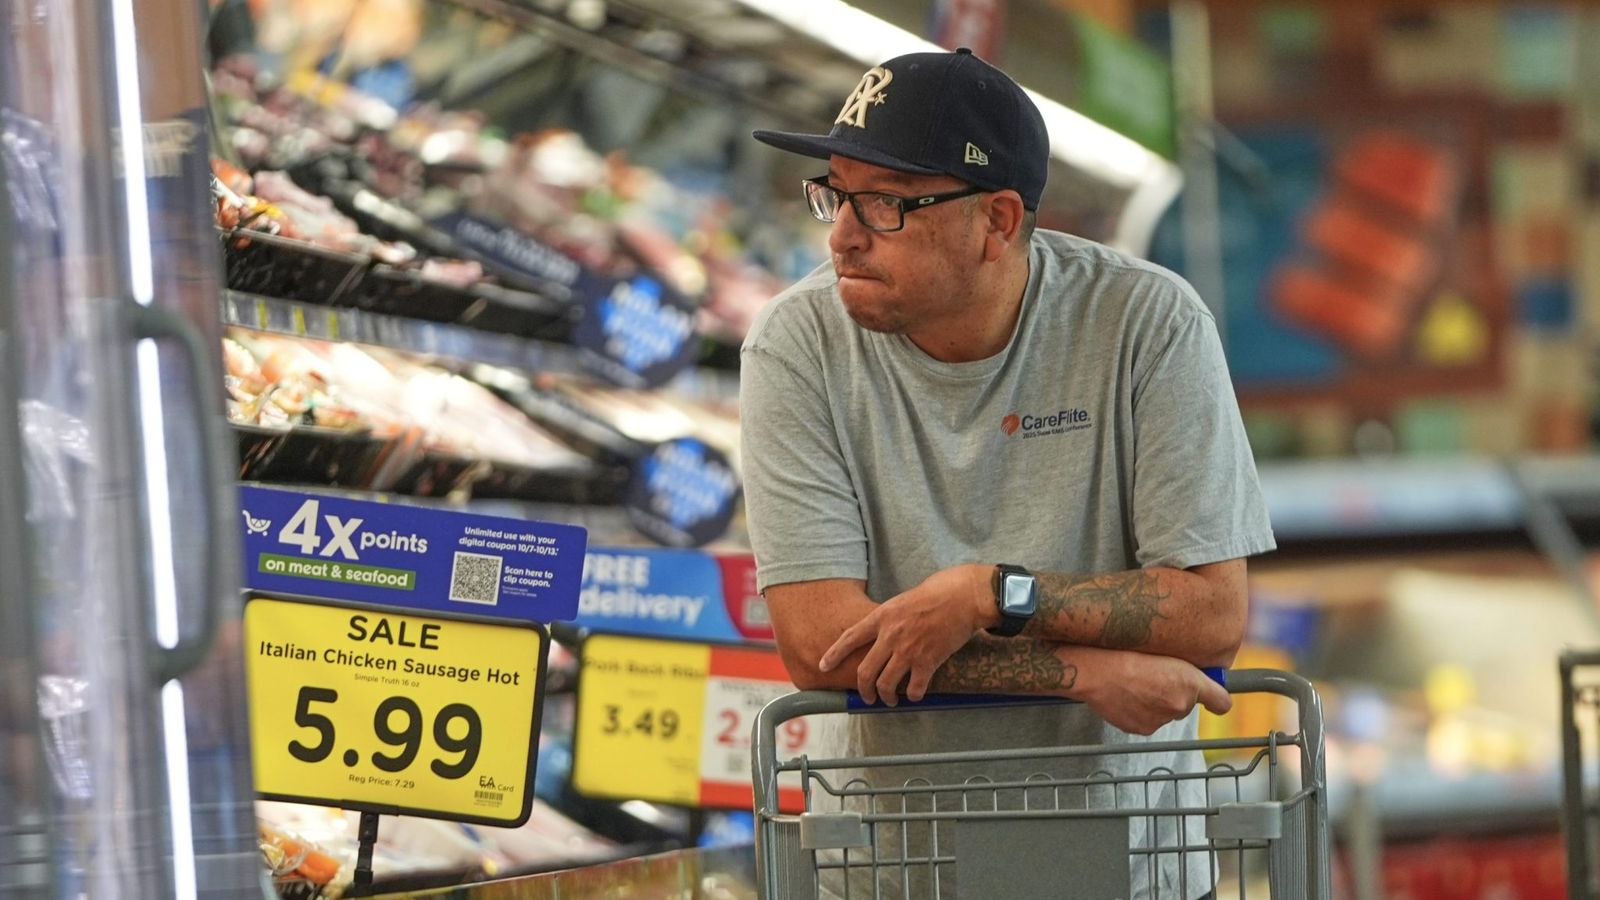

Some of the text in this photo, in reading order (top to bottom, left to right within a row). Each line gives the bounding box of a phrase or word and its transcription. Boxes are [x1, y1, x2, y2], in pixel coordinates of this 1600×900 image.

[360, 531, 428, 553] points
[458, 537, 485, 547] digital
[486, 541, 516, 551] coupon
[464, 527, 556, 545] Unlimited use with your
[265, 559, 408, 587] on meat & seafood
[503, 575, 551, 587] clip coupon.
[504, 566, 553, 579] Scan here to
[584, 553, 650, 587] FREE
[578, 587, 705, 627] delivery
[347, 615, 441, 650] SALE
[260, 641, 520, 685] Italian Chicken Sausage Hot
[354, 673, 379, 684] Simple
[381, 676, 401, 686] Truth
[401, 679, 410, 687] 16
[288, 686, 482, 779] 5.99
[602, 704, 680, 740] 3.49
[716, 708, 808, 752] 2.9
[349, 774, 415, 788] Reg Price: 7.29
[479, 775, 495, 788] EA
[497, 784, 514, 792] Card
